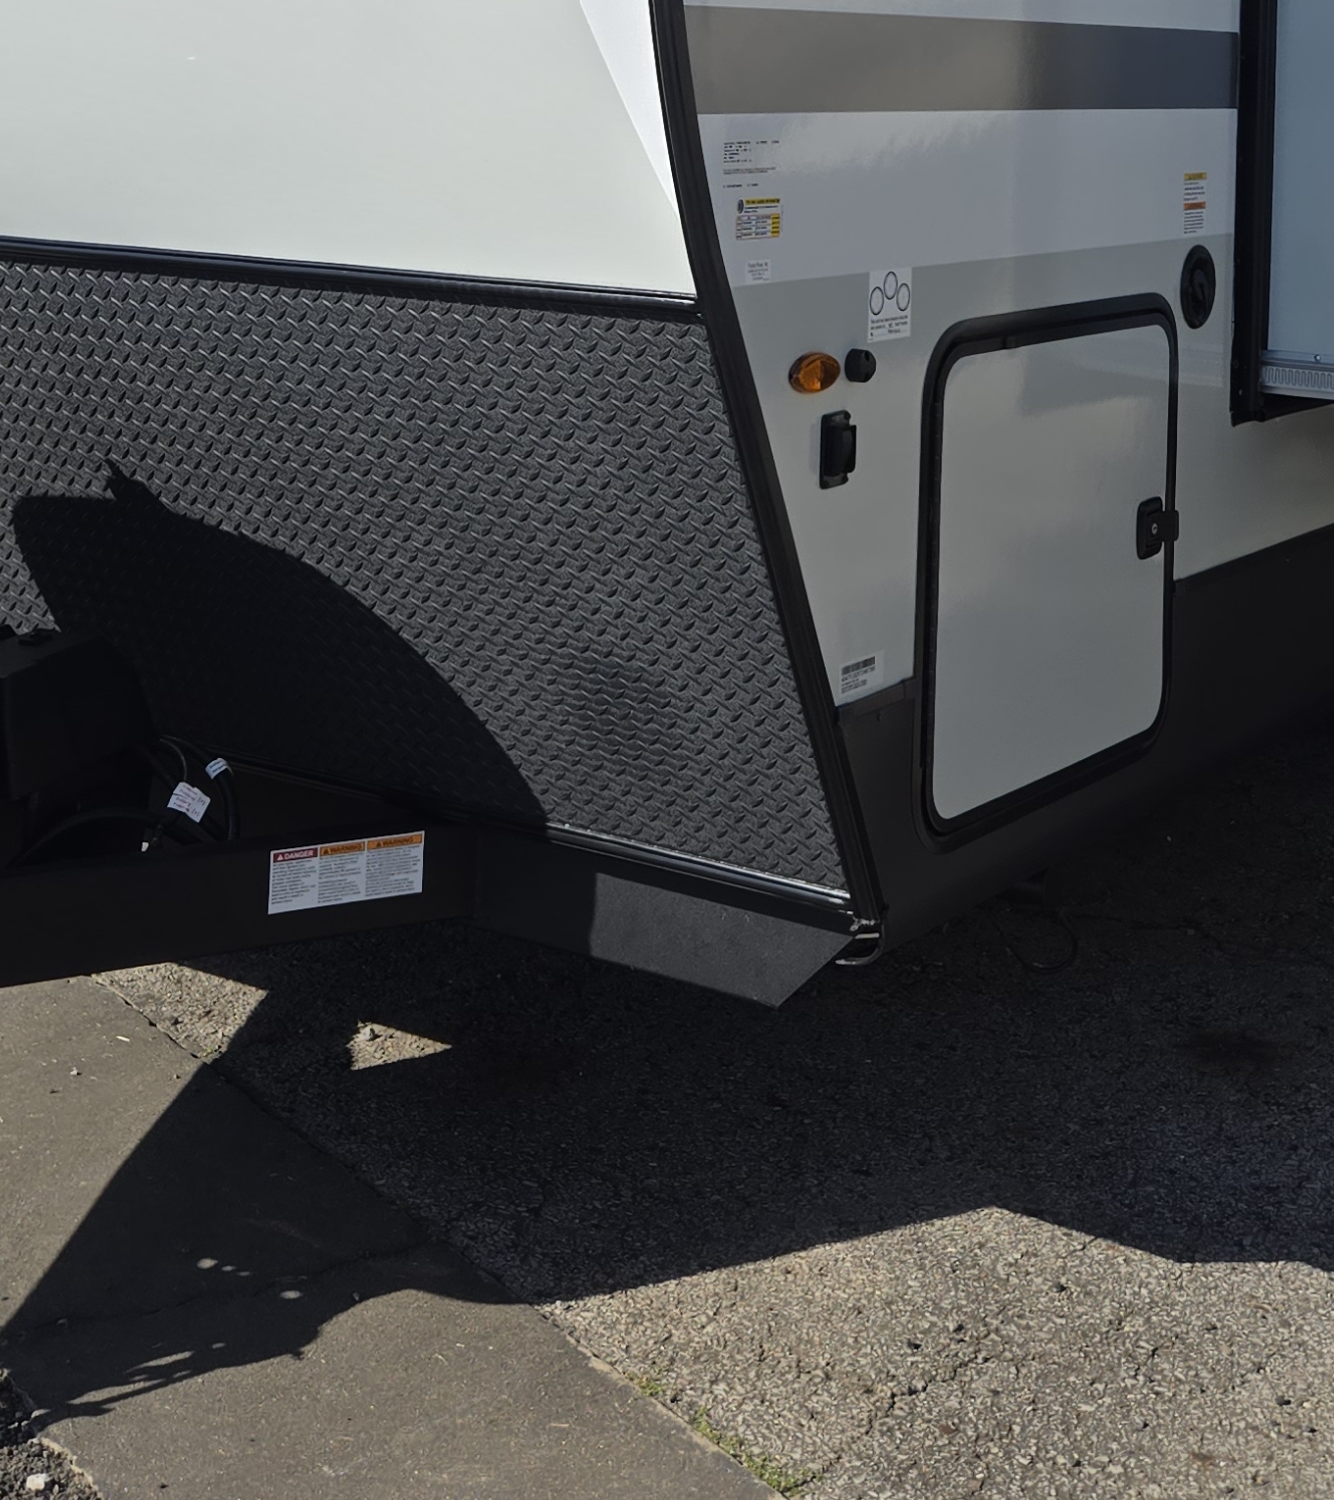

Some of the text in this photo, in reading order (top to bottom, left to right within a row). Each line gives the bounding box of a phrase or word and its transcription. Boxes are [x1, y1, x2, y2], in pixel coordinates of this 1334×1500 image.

[382, 837, 414, 846] WARNING
[330, 843, 362, 853] WARNING
[284, 849, 314, 860] DANGER
